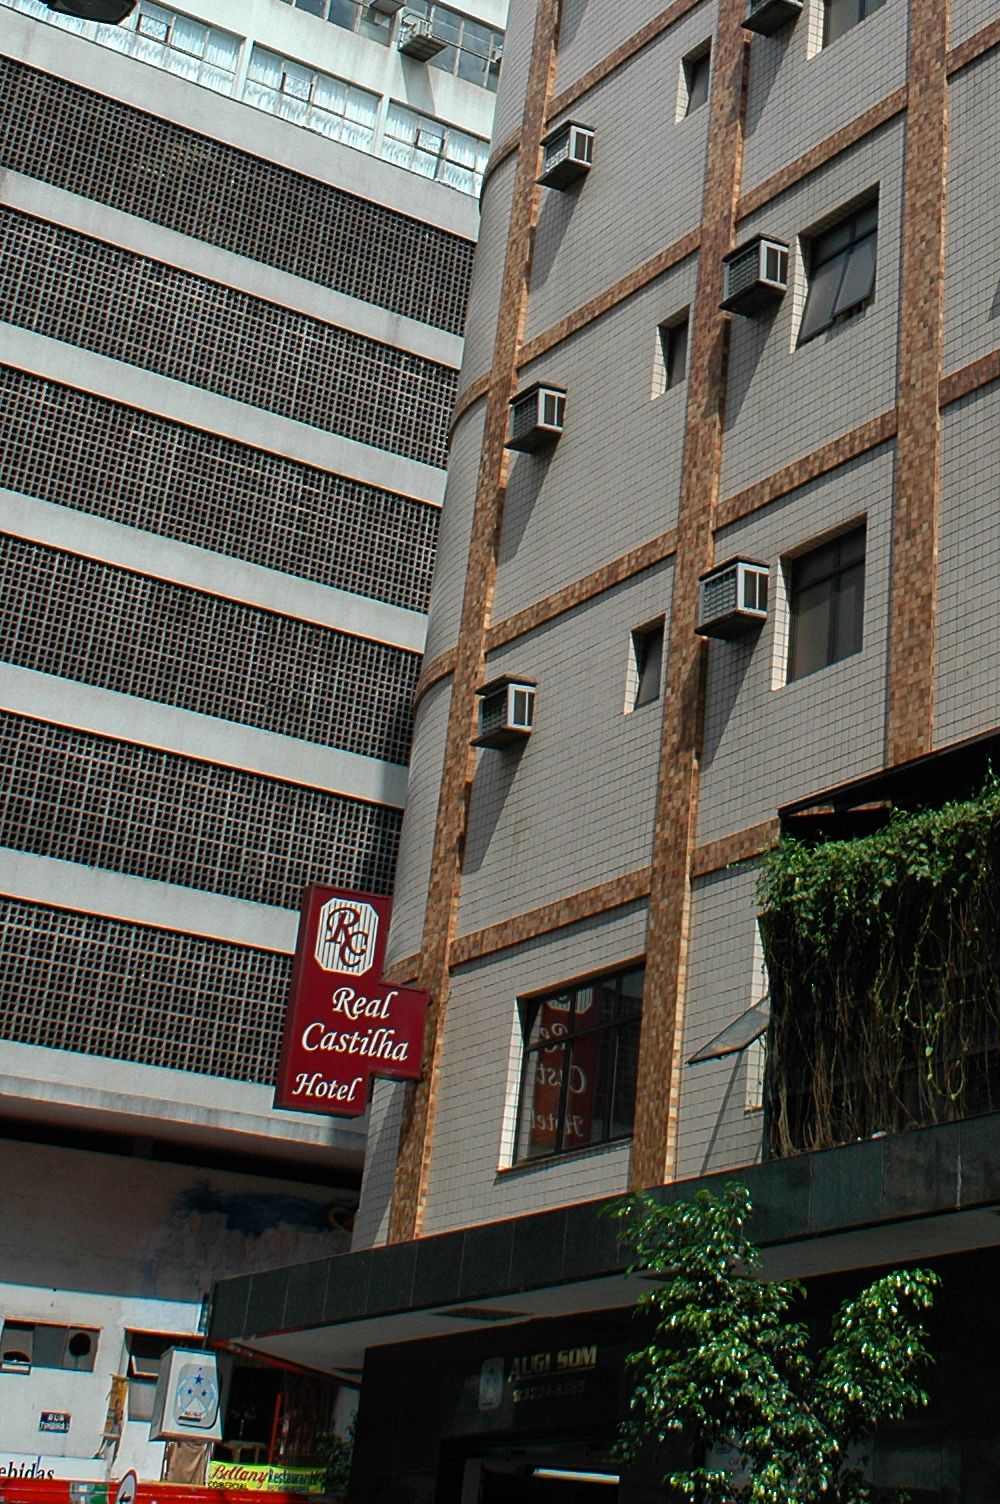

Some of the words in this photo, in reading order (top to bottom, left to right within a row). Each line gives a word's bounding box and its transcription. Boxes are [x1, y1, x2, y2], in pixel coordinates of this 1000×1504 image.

[332, 987, 399, 1020] Real
[301, 1022, 409, 1062] Castilha
[291, 1073, 363, 1102] Hotel
